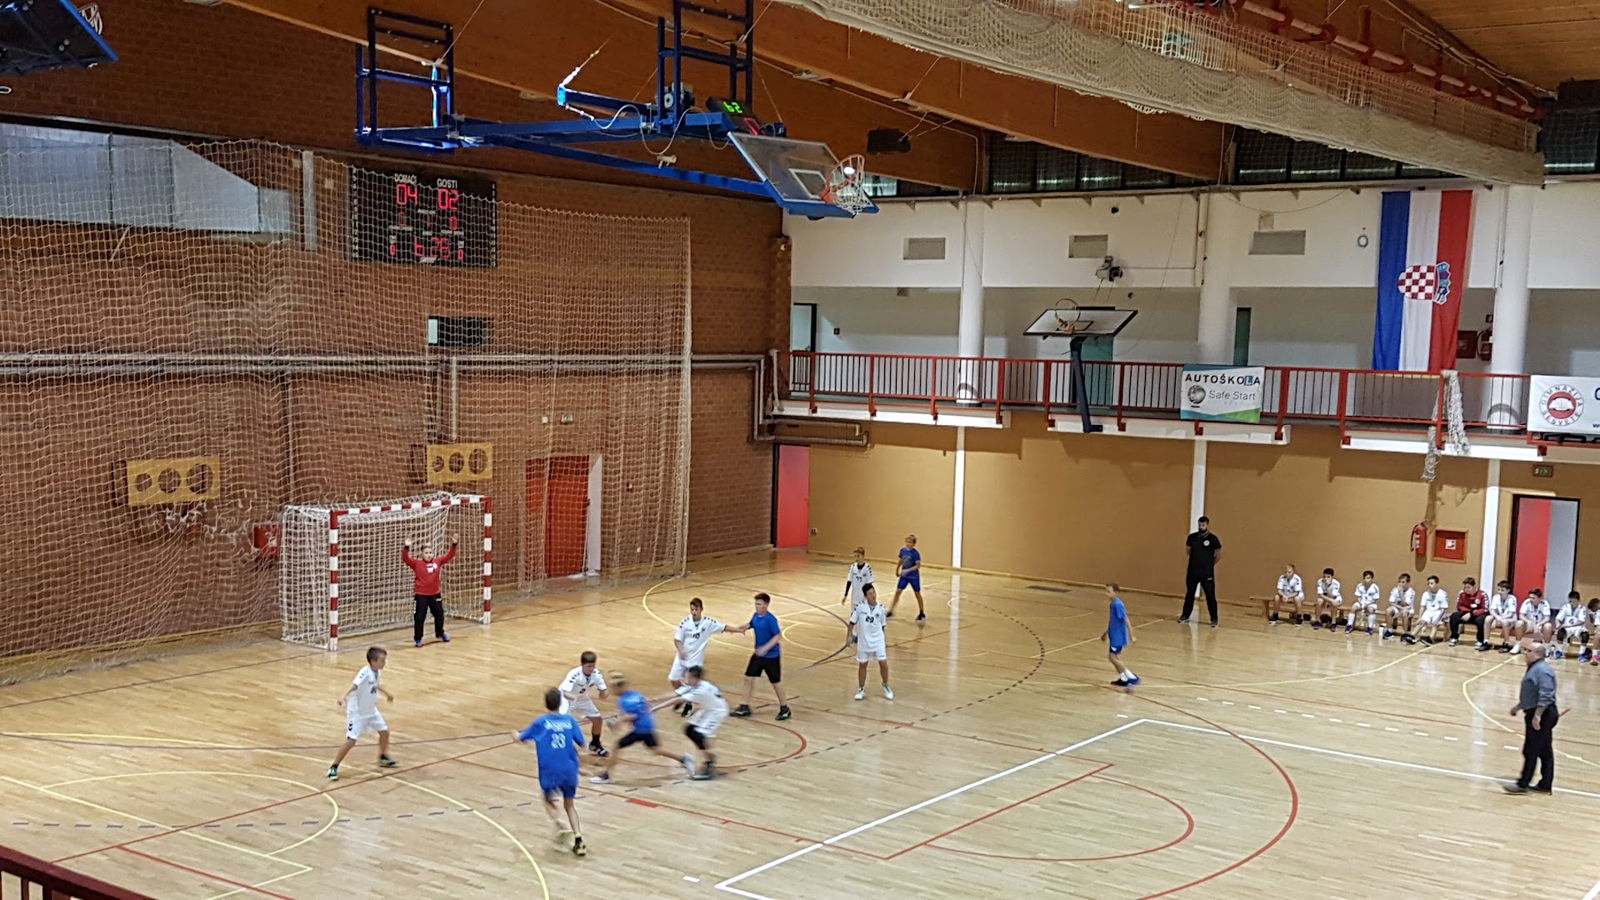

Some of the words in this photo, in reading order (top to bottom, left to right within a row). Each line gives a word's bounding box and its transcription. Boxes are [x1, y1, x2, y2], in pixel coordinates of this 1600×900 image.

[437, 178, 458, 189] GOSTI
[396, 184, 418, 206] 04
[438, 188, 460, 210] 02
[1185, 373, 1261, 386] AUTOŠKOLA
[1208, 390, 1231, 400] Safe
[1232, 391, 1257, 400] Start
